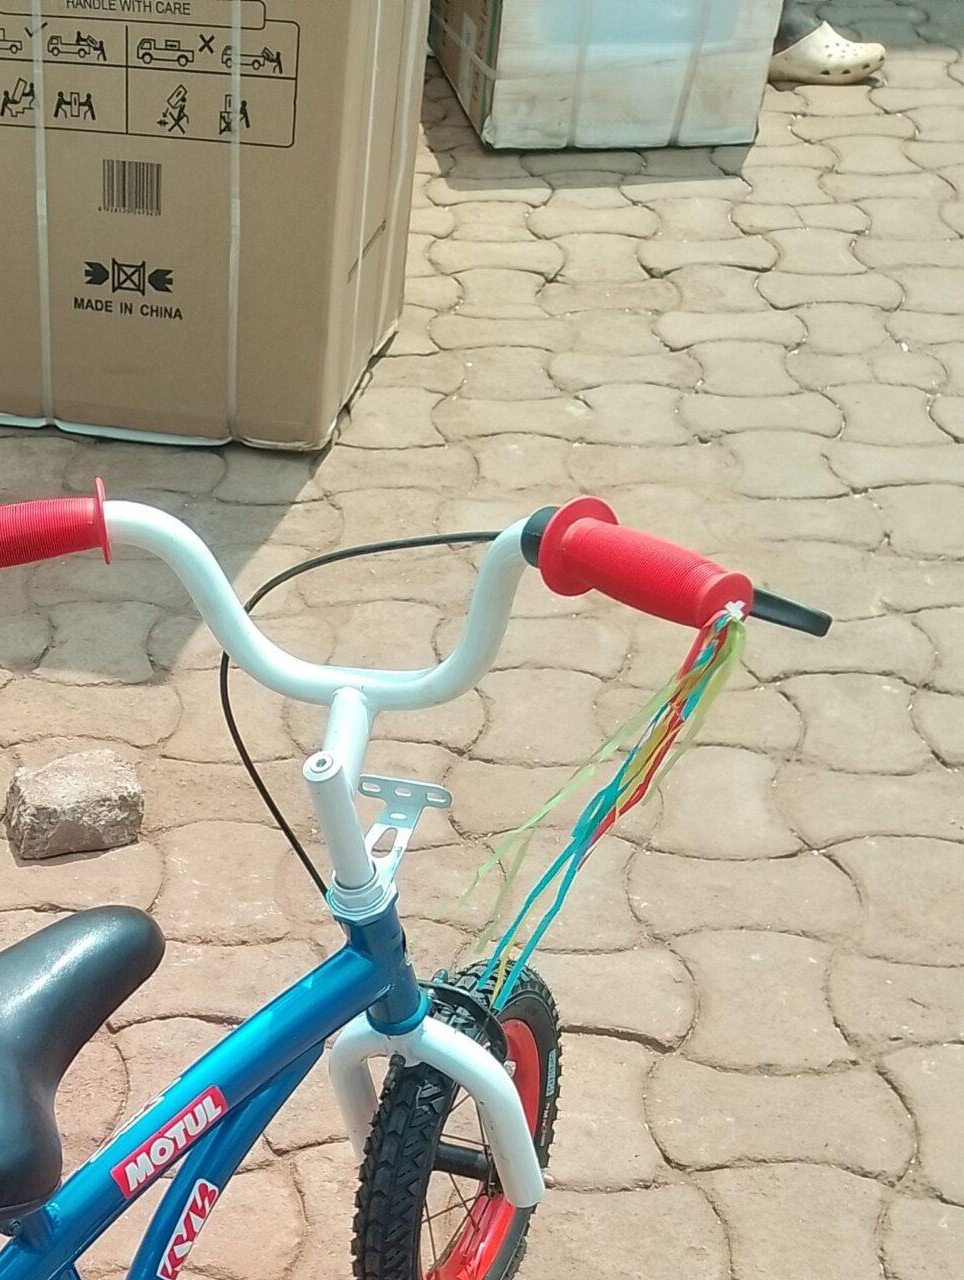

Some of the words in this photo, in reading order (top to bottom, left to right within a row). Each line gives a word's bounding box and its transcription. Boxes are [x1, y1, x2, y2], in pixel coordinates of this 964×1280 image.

[119, 0, 152, 13] WITH
[155, 1, 191, 15] CARE
[74, 297, 113, 313] MADE
[120, 302, 133, 315] IN
[140, 304, 183, 320] CHINA
[124, 1094, 222, 1192] MOTUL
